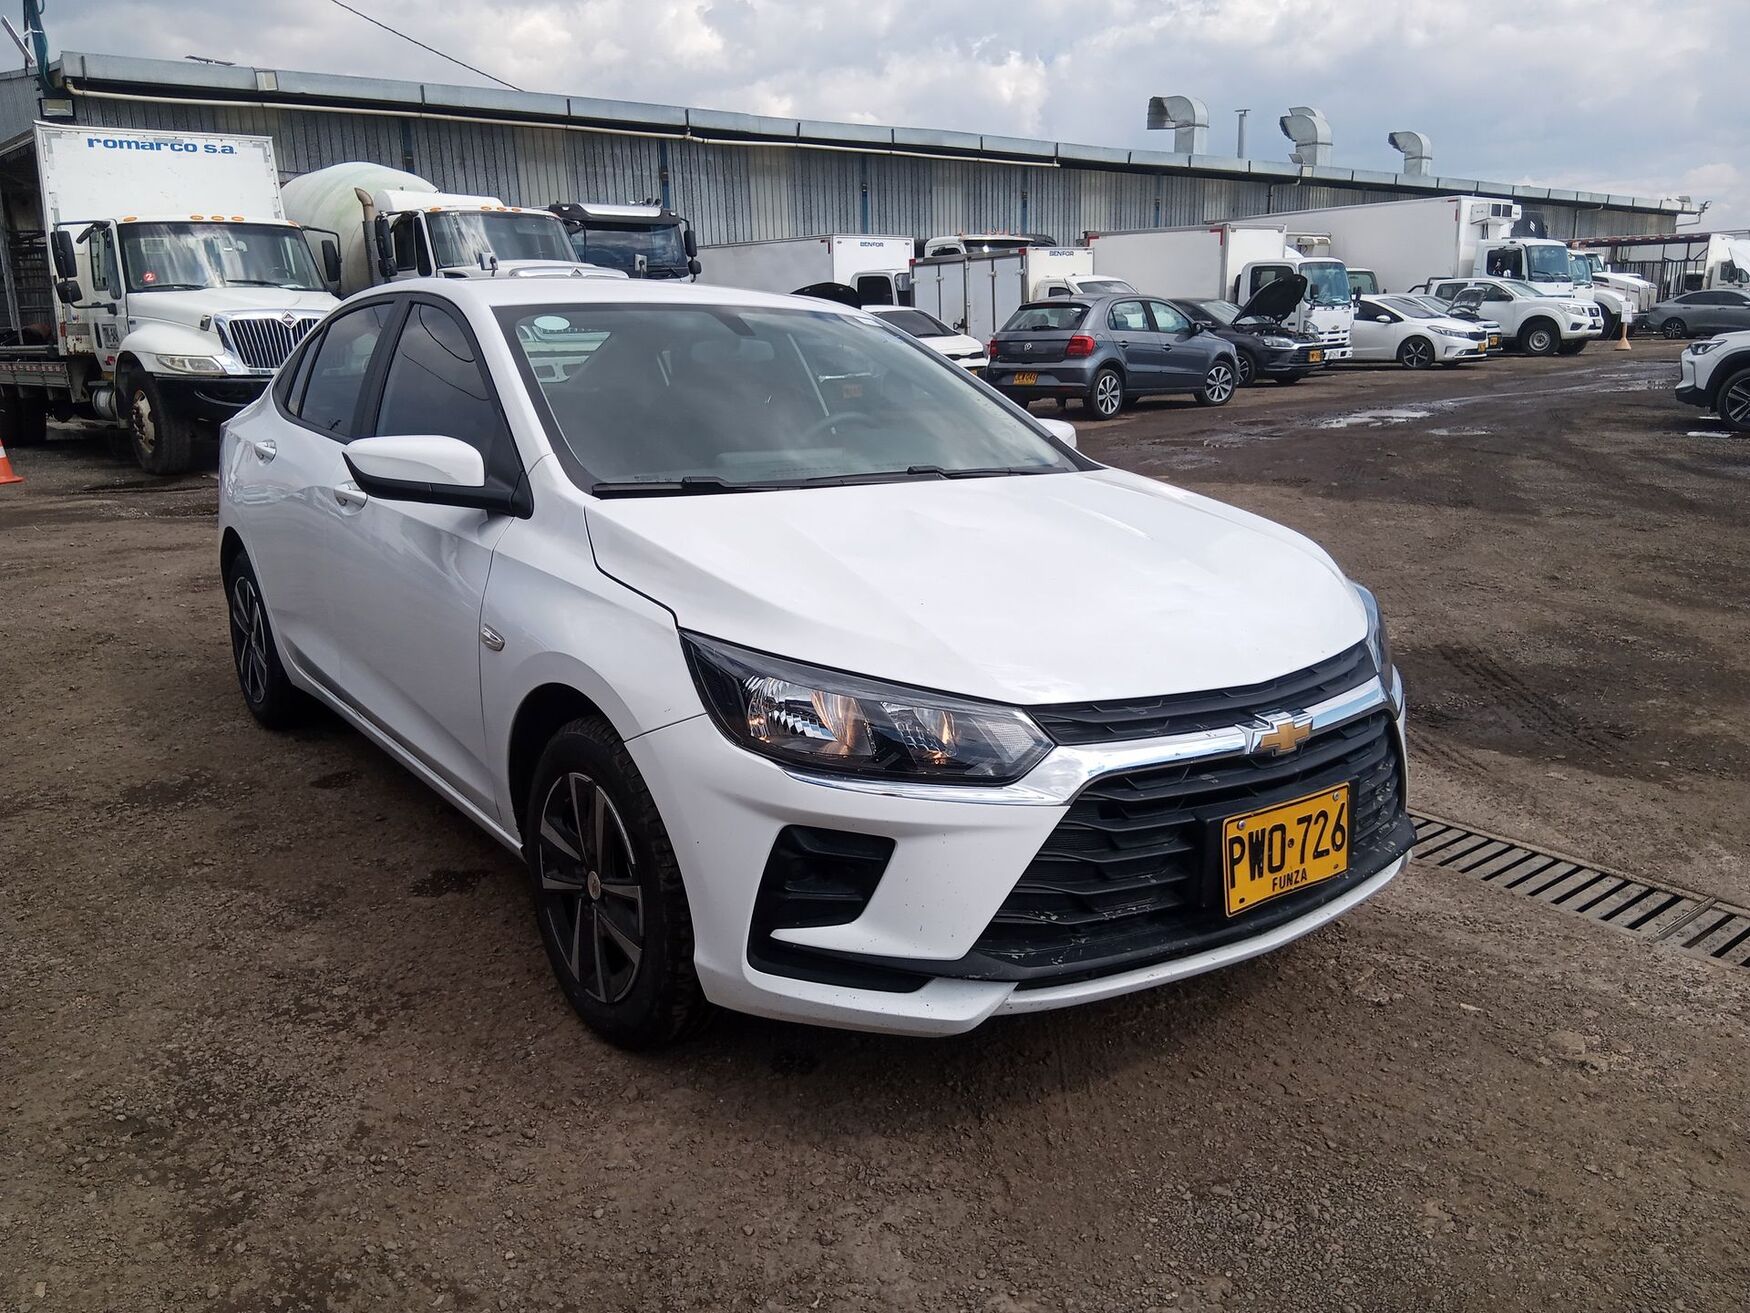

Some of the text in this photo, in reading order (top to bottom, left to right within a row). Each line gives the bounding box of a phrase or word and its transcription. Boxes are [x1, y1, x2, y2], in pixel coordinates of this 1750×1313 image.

[87, 137, 238, 155] romarco s.a.
[1271, 867, 1308, 892] FUNZA
